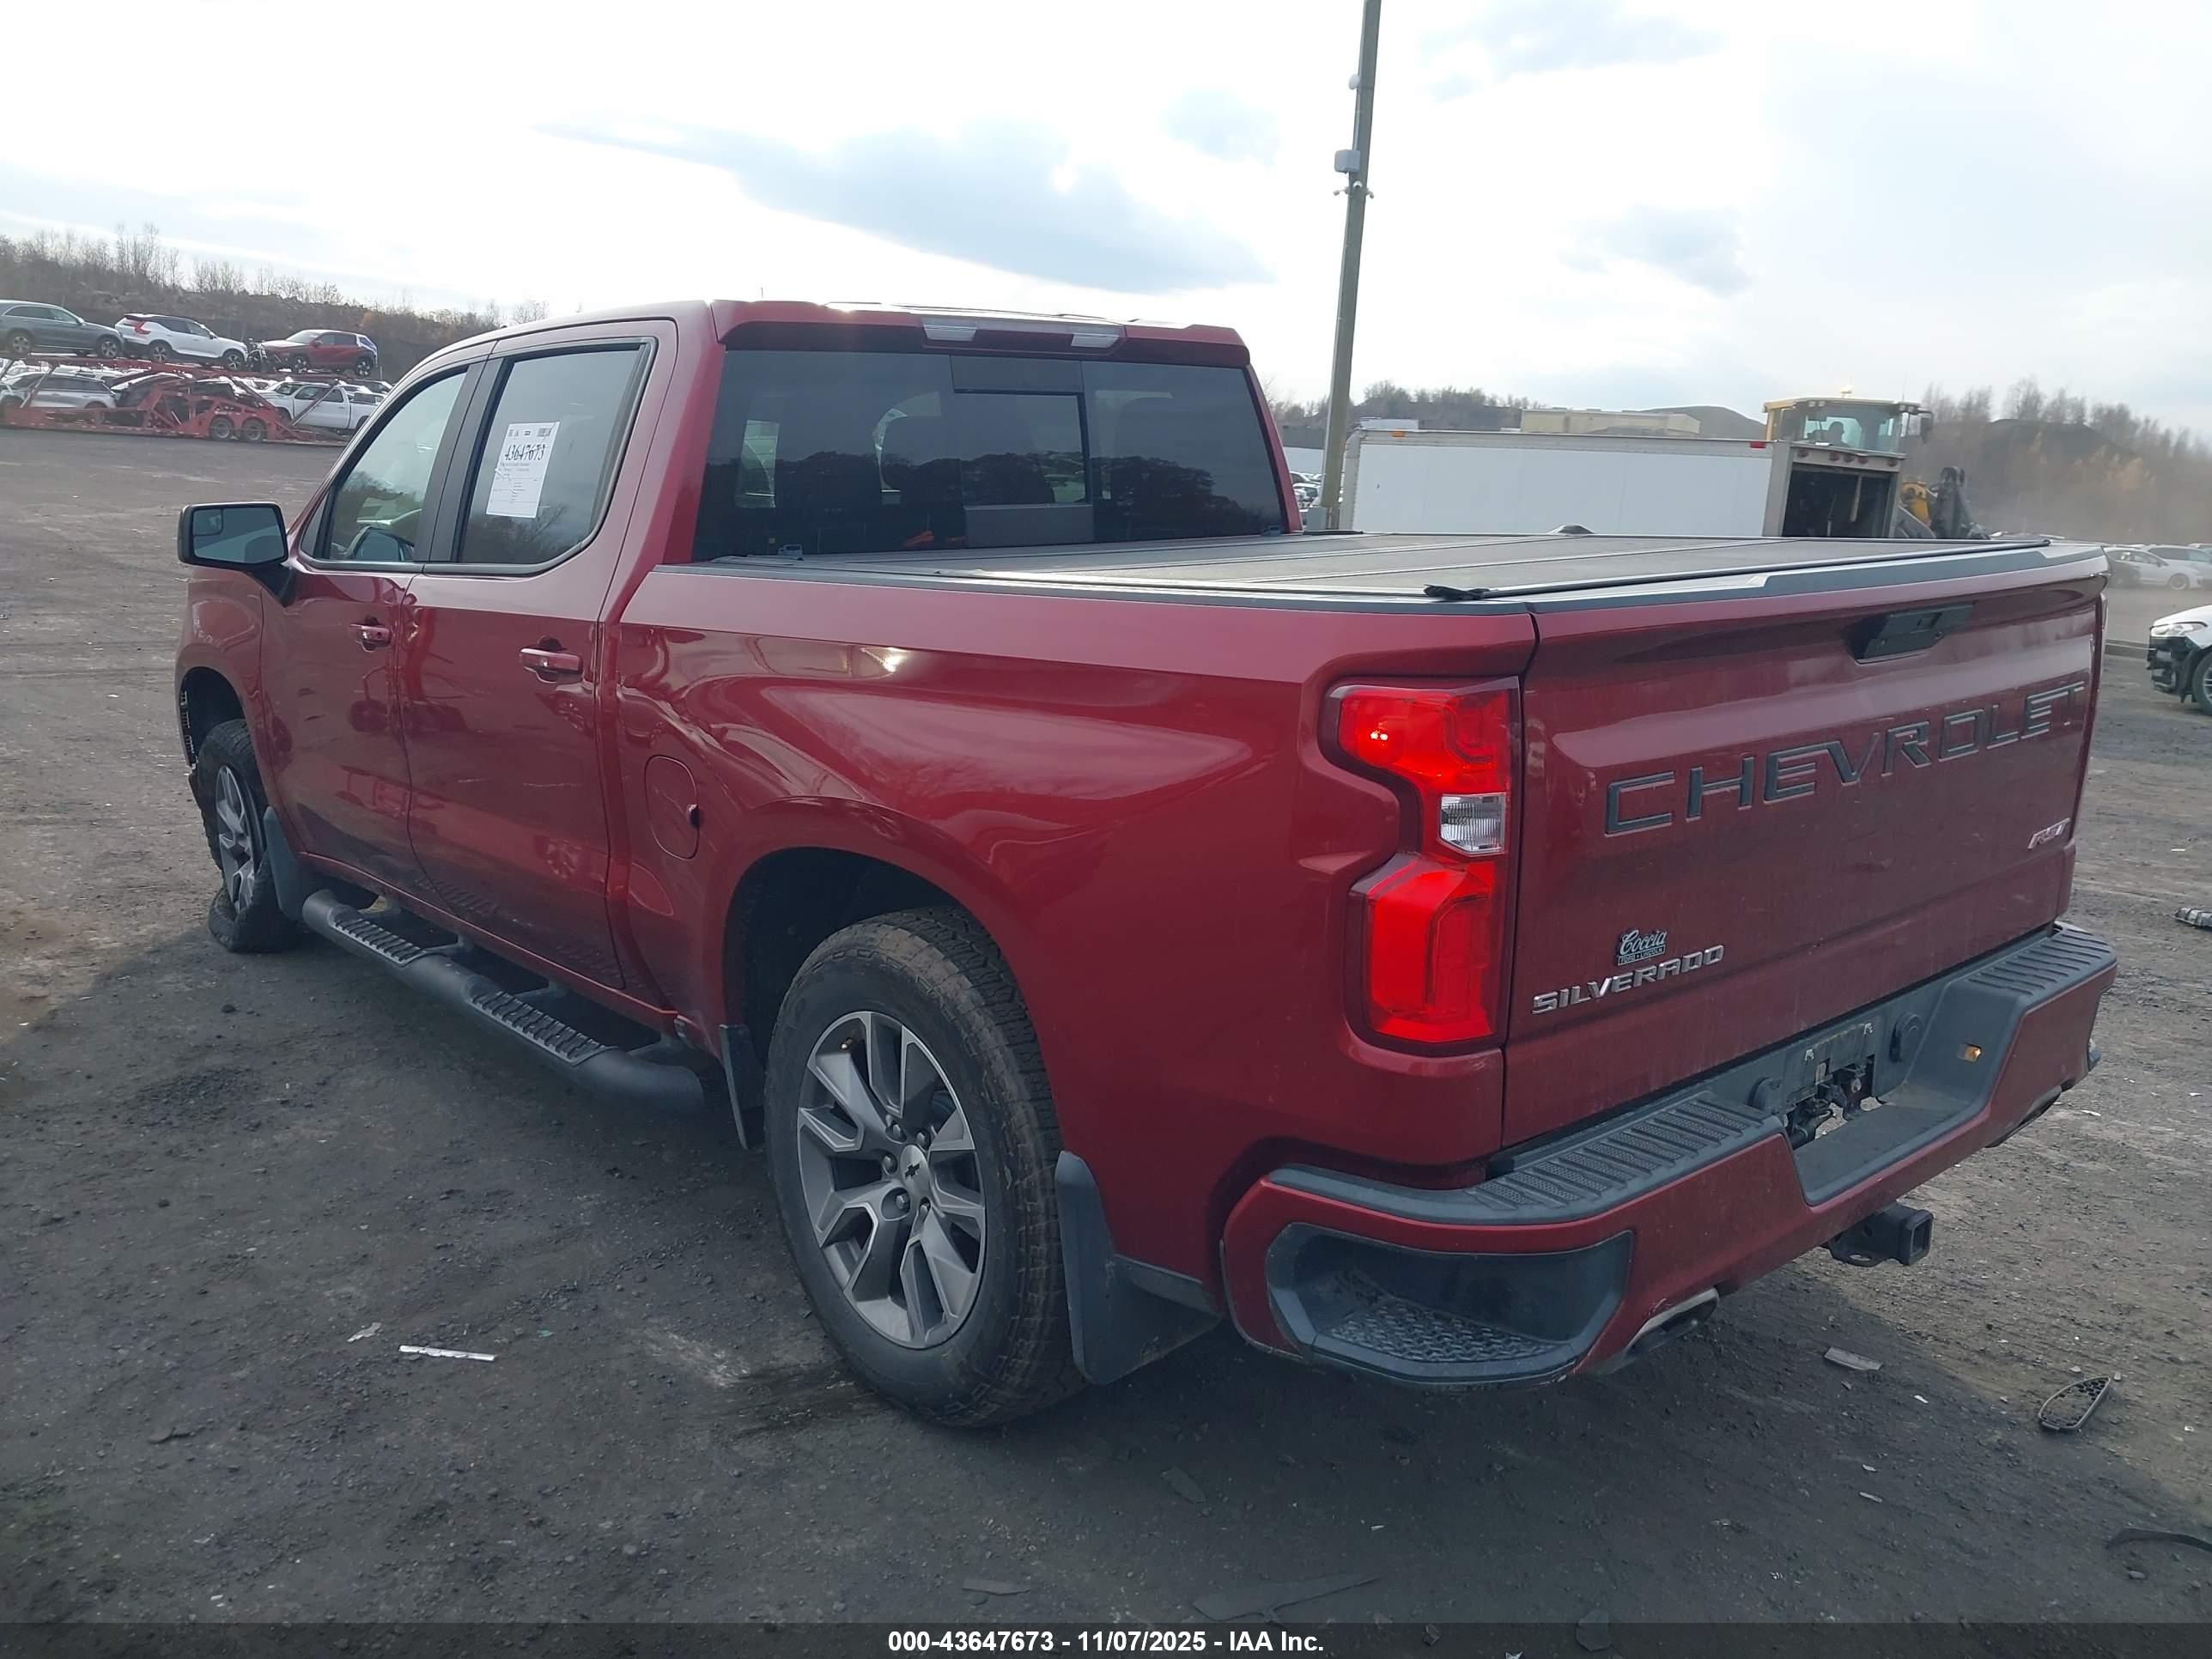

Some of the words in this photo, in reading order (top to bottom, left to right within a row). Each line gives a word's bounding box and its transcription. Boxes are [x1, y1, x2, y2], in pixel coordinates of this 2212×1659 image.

[504, 443, 546, 461] 43647673
[1604, 680, 2085, 837] CHEVROLET
[2027, 817, 2071, 849] RST
[1619, 928, 1668, 956] Coccia
[1620, 955, 1636, 964] FORD
[1640, 946, 1664, 958] LINCOLN
[1531, 945, 1725, 1014] SILVERADO
